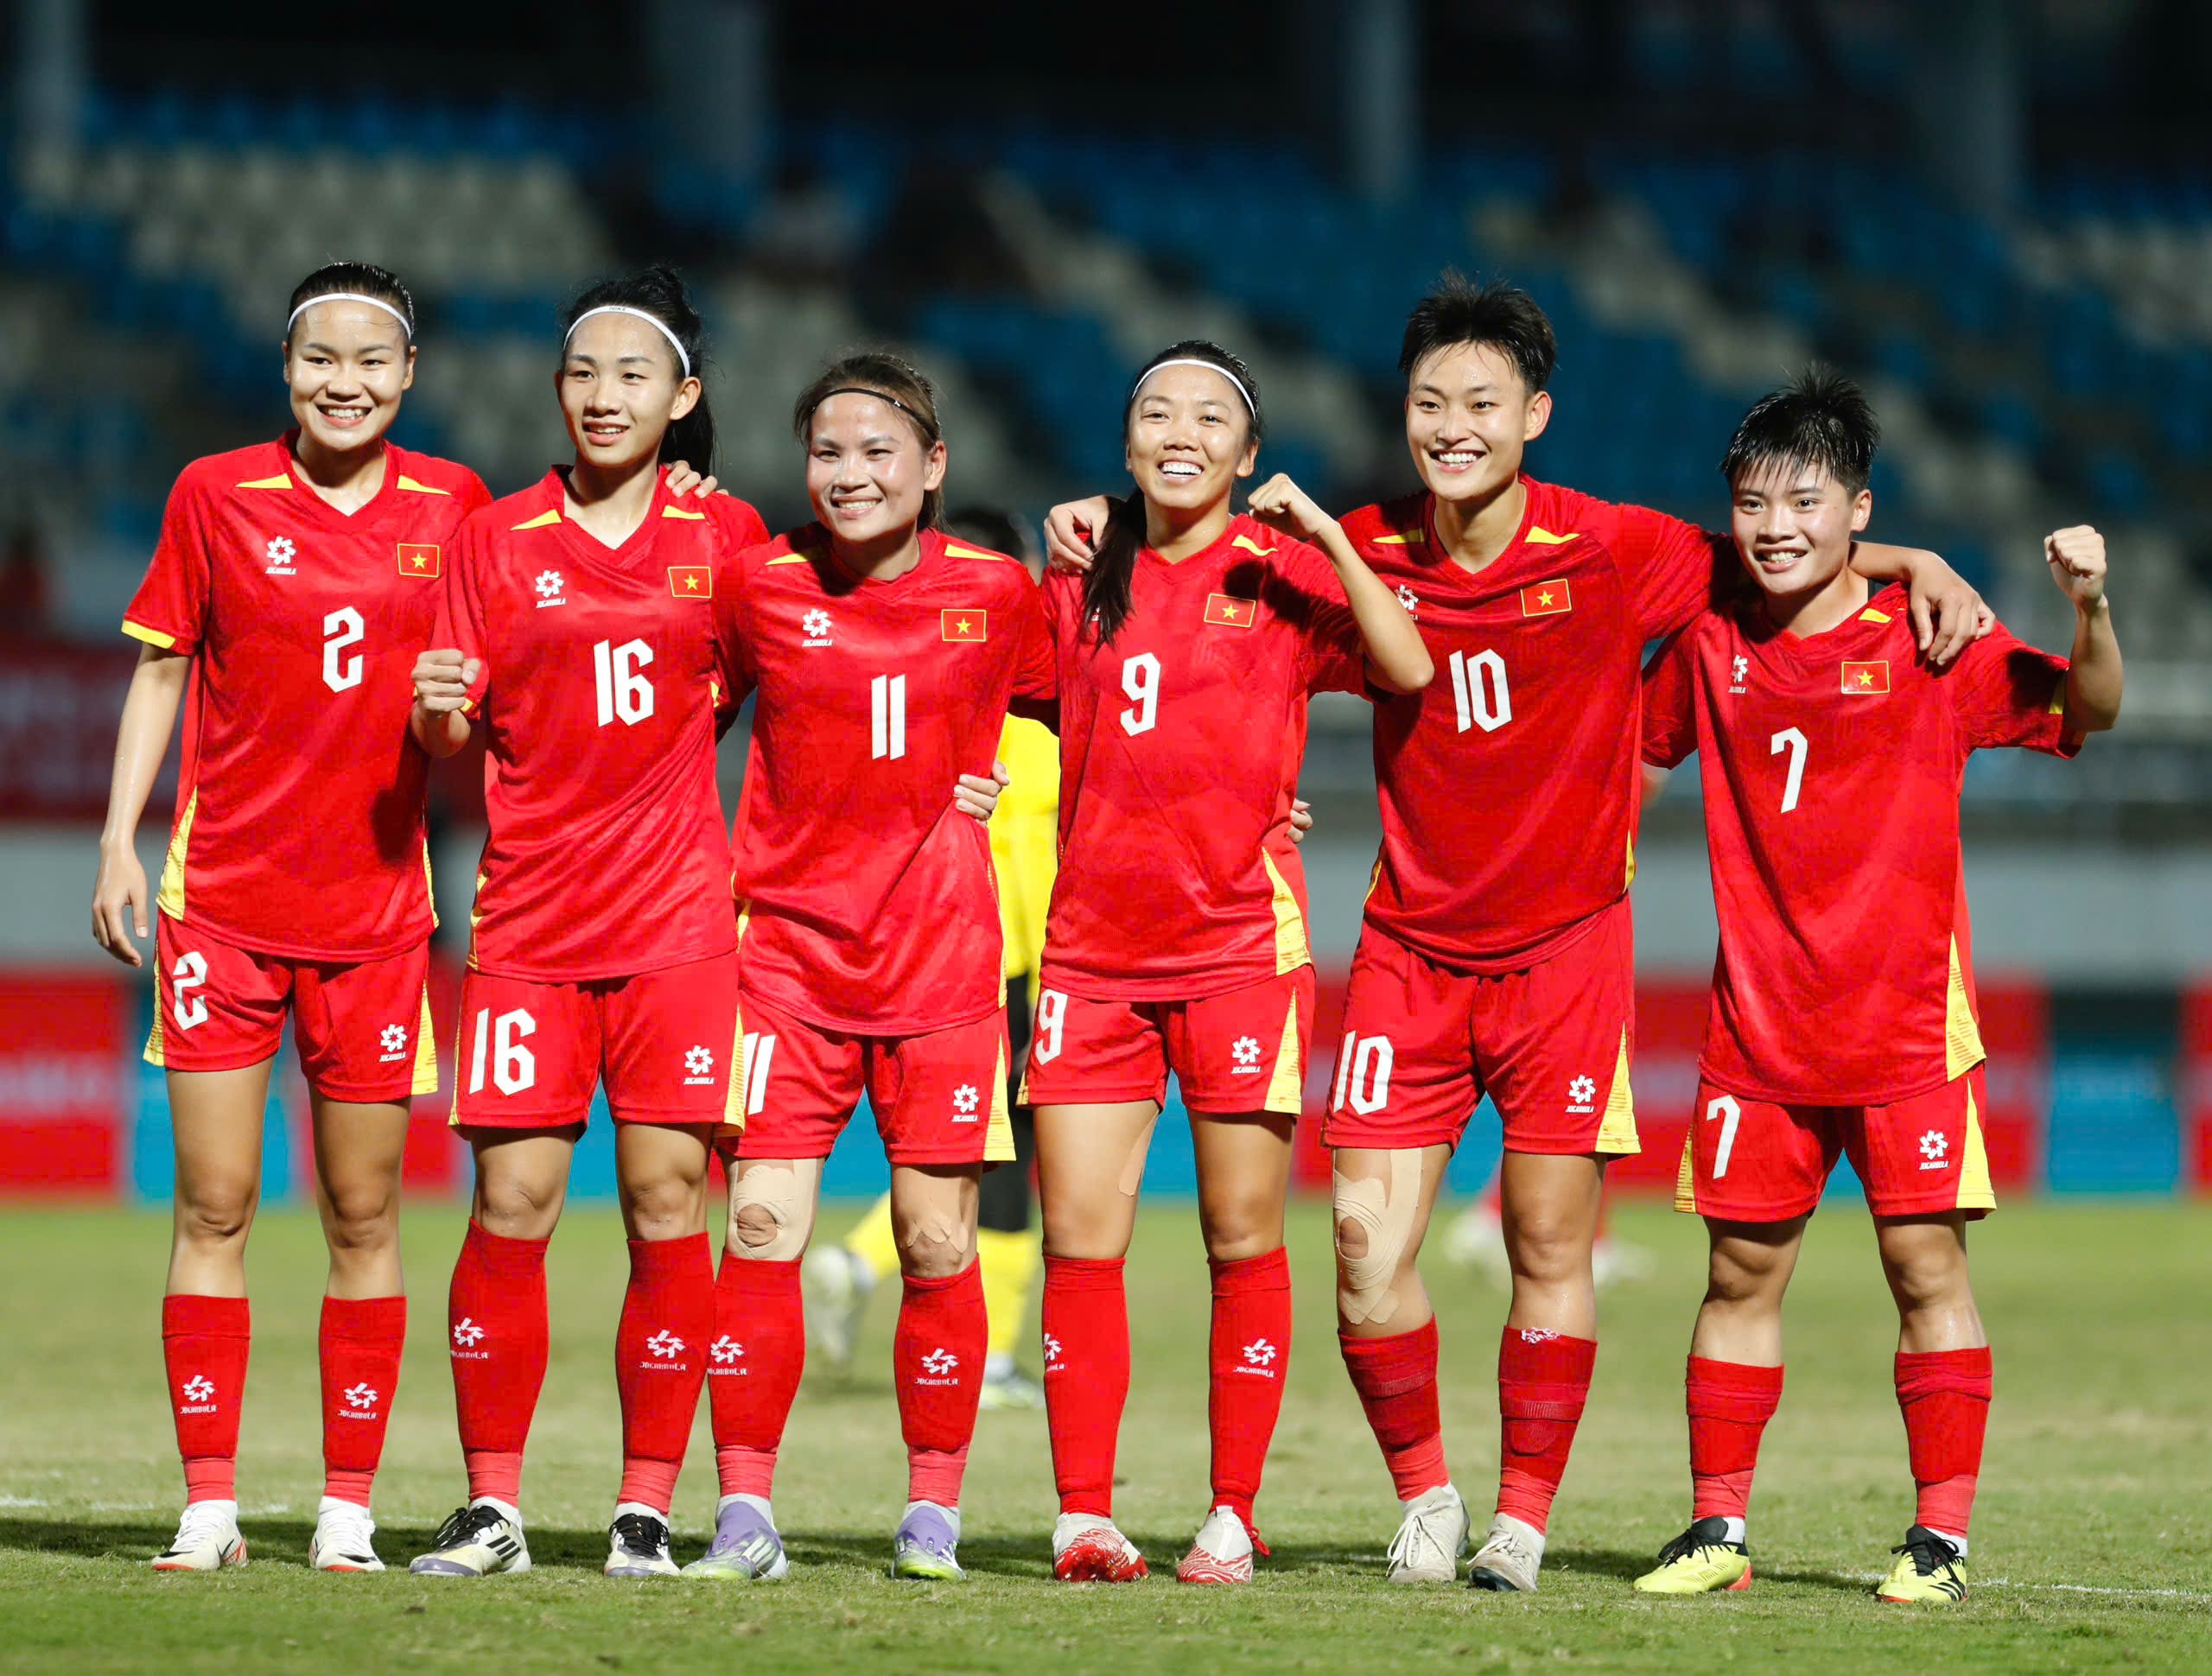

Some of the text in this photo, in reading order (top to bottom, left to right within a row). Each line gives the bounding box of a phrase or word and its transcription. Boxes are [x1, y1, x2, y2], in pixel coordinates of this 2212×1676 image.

[323, 606, 364, 692] 2
[594, 638, 653, 727] 16
[1450, 649, 1511, 733] 10
[872, 675, 905, 759] 11
[1121, 652, 1160, 736] 9
[1771, 727, 1808, 813] 7
[173, 951, 207, 1030] 2
[1034, 989, 1068, 1065] 9
[469, 1008, 536, 1095] 16
[1334, 1031, 1393, 1115] 10
[1707, 1095, 1740, 1178] 7
